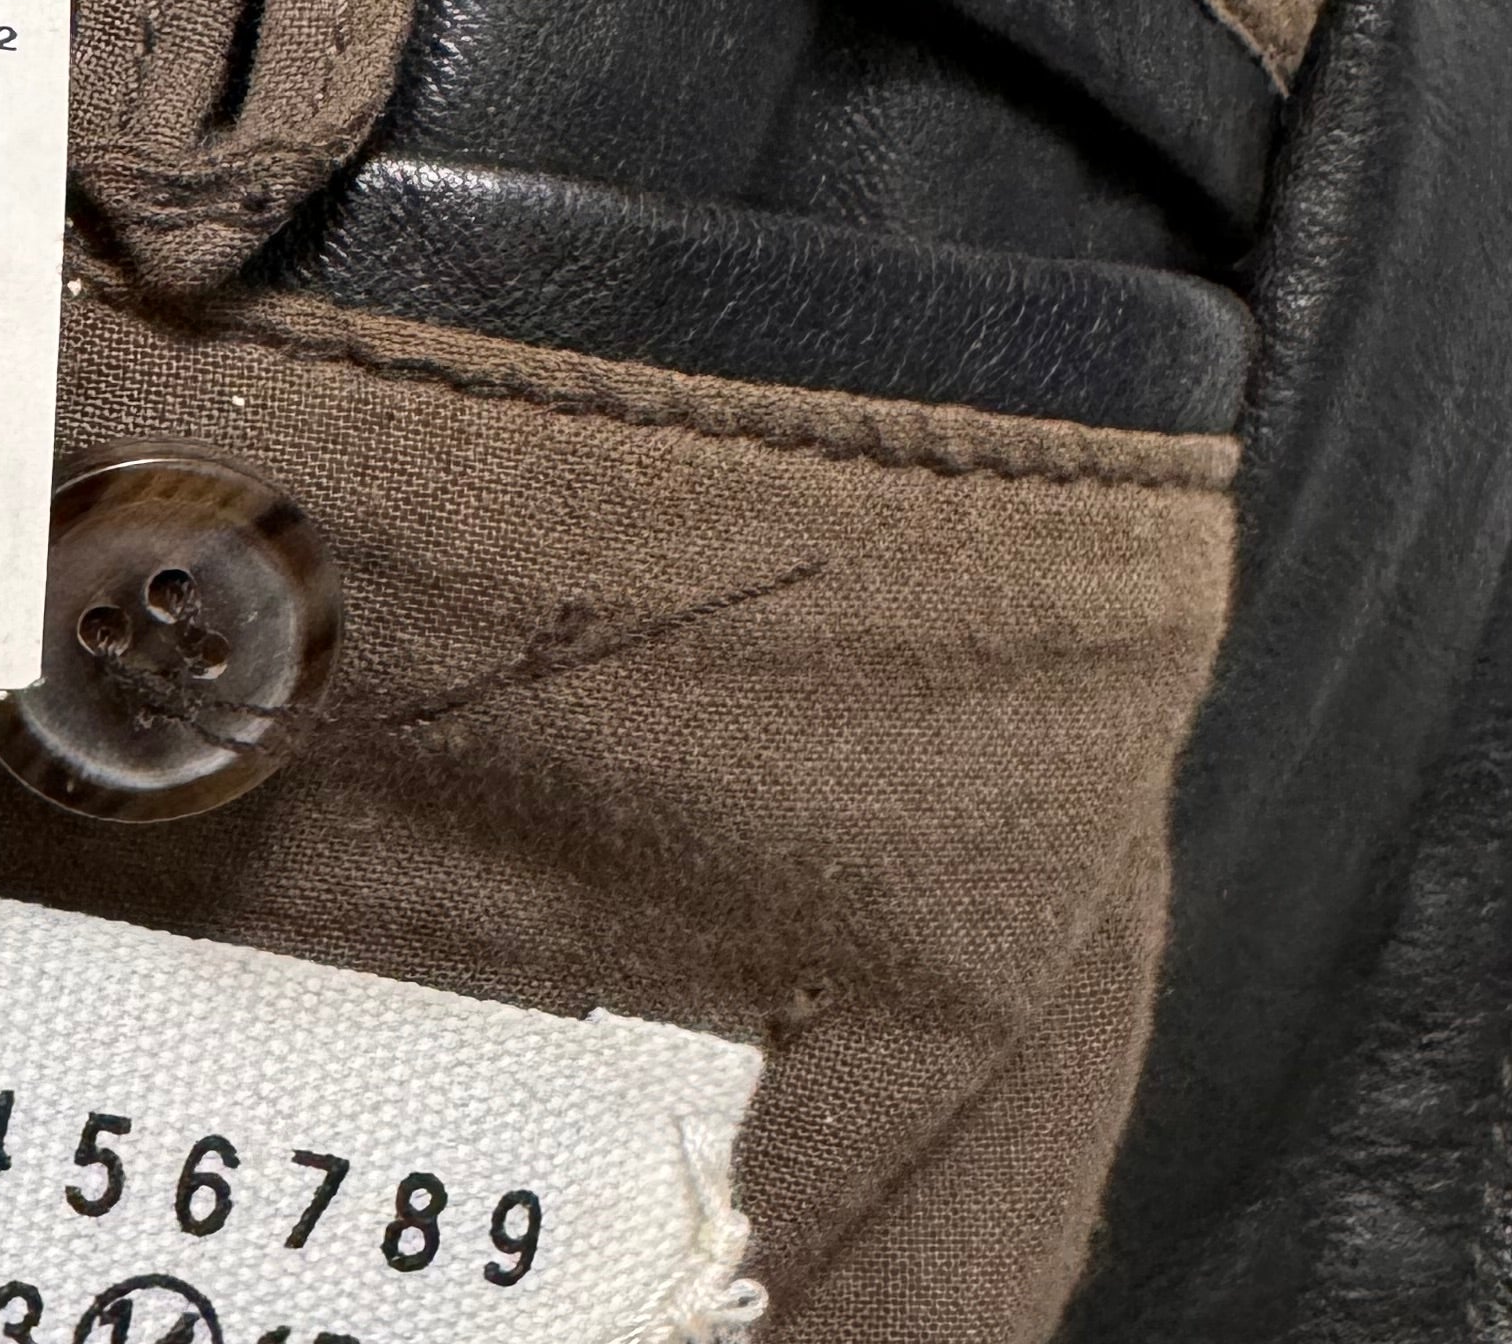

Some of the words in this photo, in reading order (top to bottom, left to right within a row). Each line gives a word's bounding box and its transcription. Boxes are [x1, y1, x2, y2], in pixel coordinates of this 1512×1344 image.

[65, 1112, 131, 1217] 5
[175, 1135, 240, 1237] 6
[285, 1150, 349, 1249] 7
[380, 1172, 447, 1272] 8
[484, 1190, 542, 1287] 9
